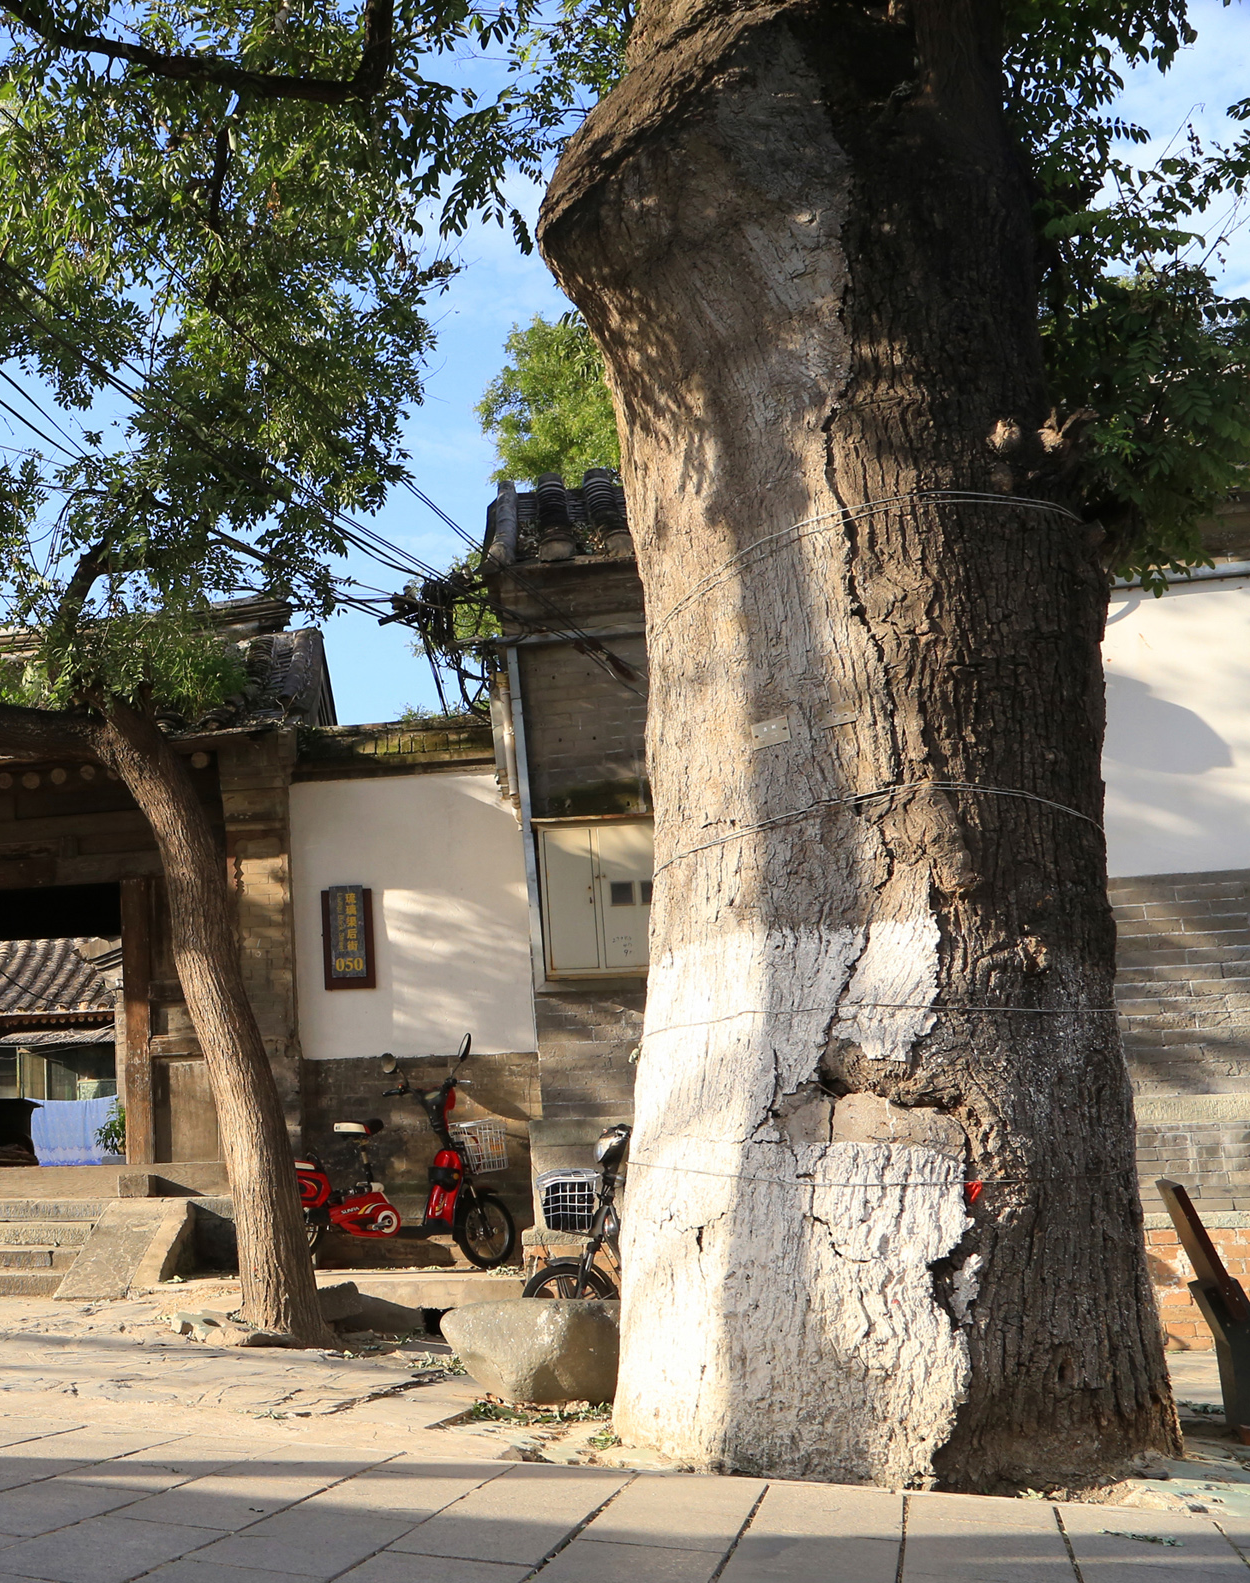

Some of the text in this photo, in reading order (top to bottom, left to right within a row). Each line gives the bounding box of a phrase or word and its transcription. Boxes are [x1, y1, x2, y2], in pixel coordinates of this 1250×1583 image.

[345, 893, 358, 951] 琉璃渠后街
[335, 957, 364, 972] 050
